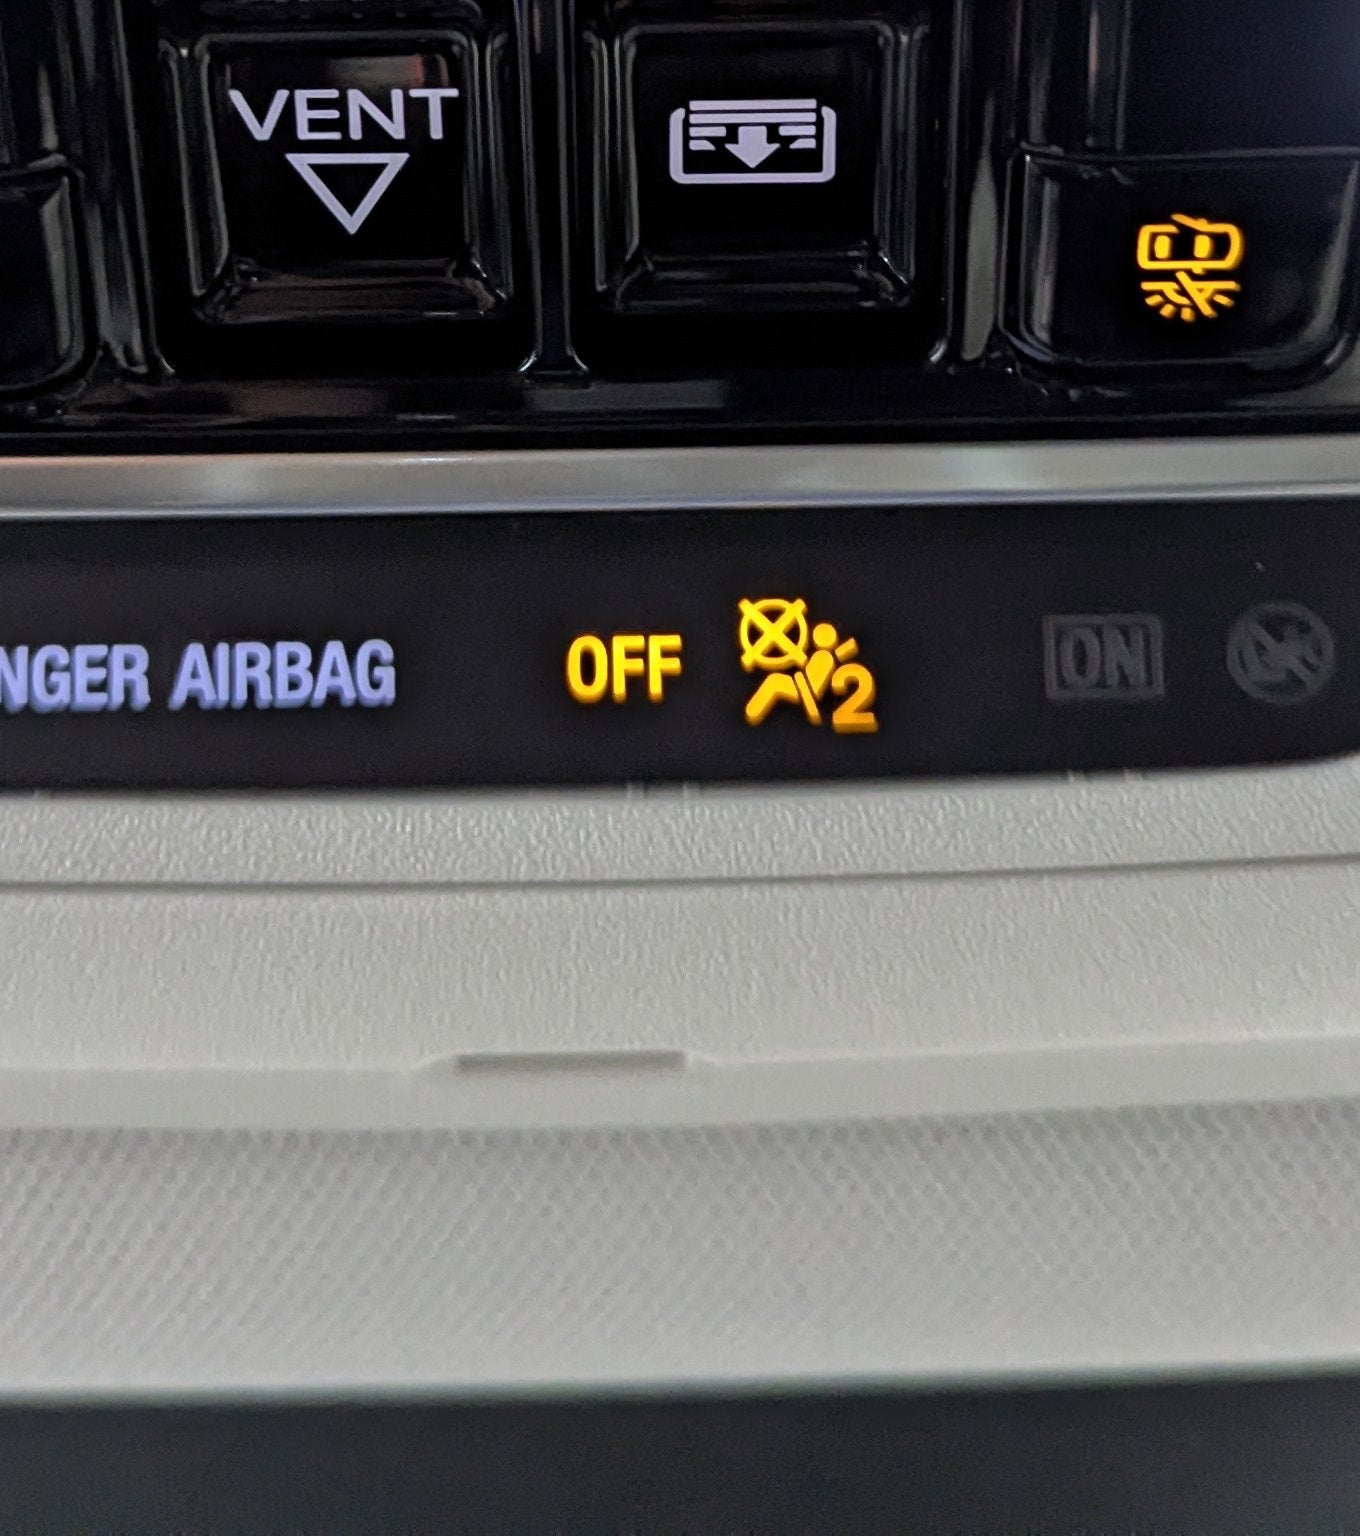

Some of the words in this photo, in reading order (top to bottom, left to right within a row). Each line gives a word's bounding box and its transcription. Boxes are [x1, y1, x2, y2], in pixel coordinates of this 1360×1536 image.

[228, 88, 460, 141] VENT
[168, 639, 396, 710] AIRBAG
[566, 634, 682, 703] OFF
[1057, 625, 1146, 689] ON
[831, 663, 878, 732] 2
